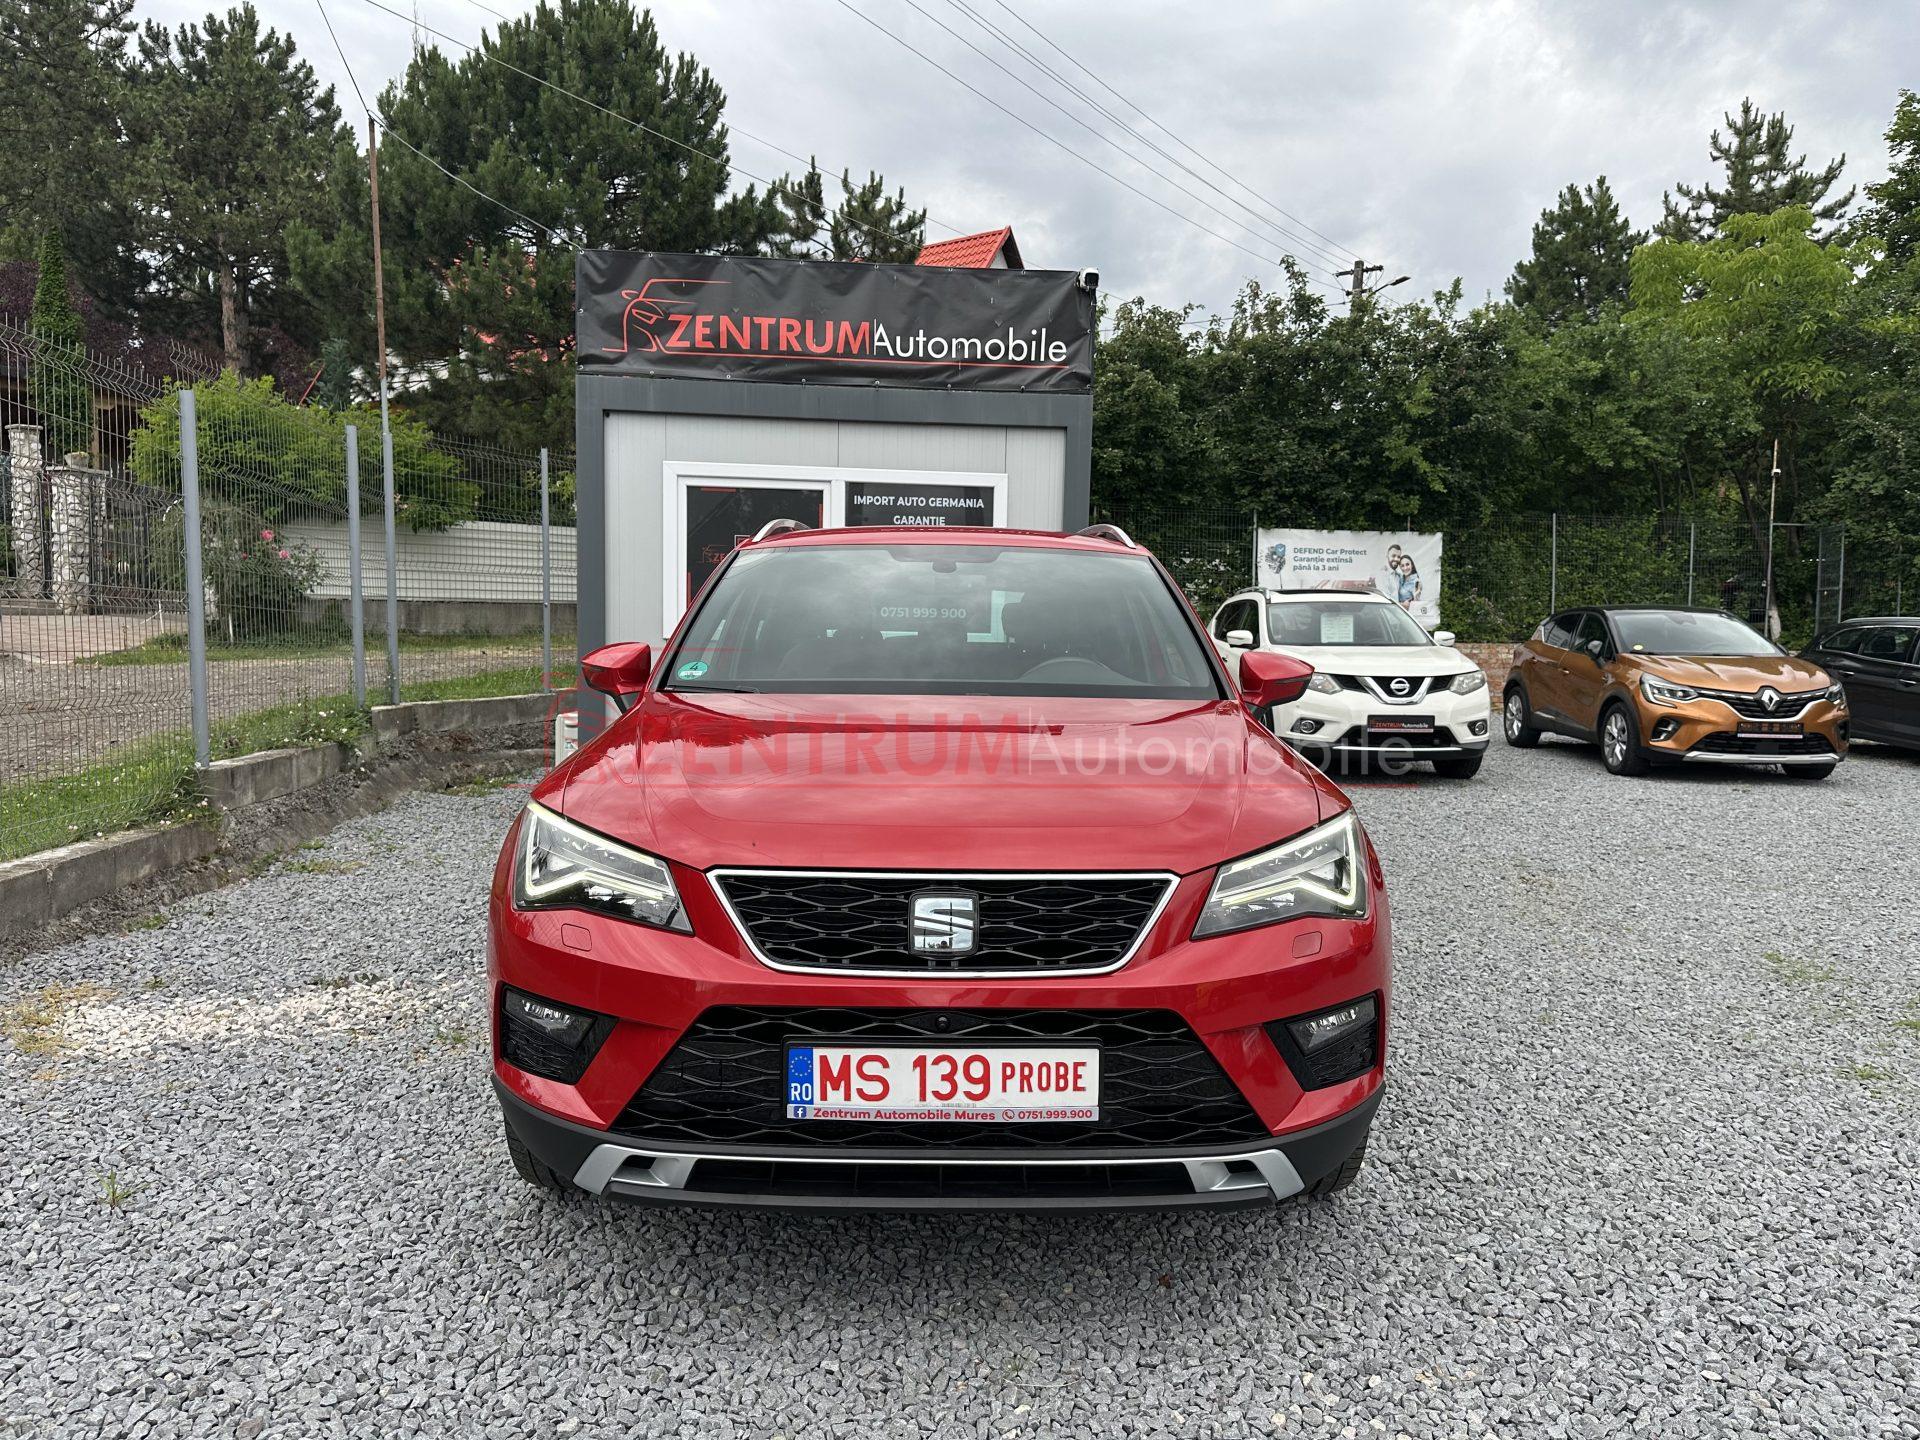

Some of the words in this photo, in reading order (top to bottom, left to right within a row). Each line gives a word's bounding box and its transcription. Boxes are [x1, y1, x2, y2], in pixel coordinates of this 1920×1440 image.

[666, 313, 871, 355] ZENTRUM
[874, 322, 1068, 363] Automobile
[853, 494, 896, 507] IMPORT
[897, 496, 926, 507] AUTO
[928, 497, 985, 509] GERMANIA
[893, 515, 946, 526] GARANTIE
[1293, 547, 1324, 555] DEFEND
[1340, 548, 1367, 556] Protect
[880, 606, 909, 618] 0751
[912, 607, 938, 618] 999
[940, 608, 967, 619] 900
[690, 662, 698, 671] 4
[819, 1054, 890, 1102] MS
[912, 1054, 991, 1102] 139
[1001, 1061, 1087, 1093] PROBE
[790, 1083, 812, 1101] RO
[813, 1108, 871, 1119] Zentrum
[874, 1109, 951, 1120] Automobile
[954, 1109, 996, 1121] Mures
[1017, 1108, 1093, 1120] 0751.999.900
